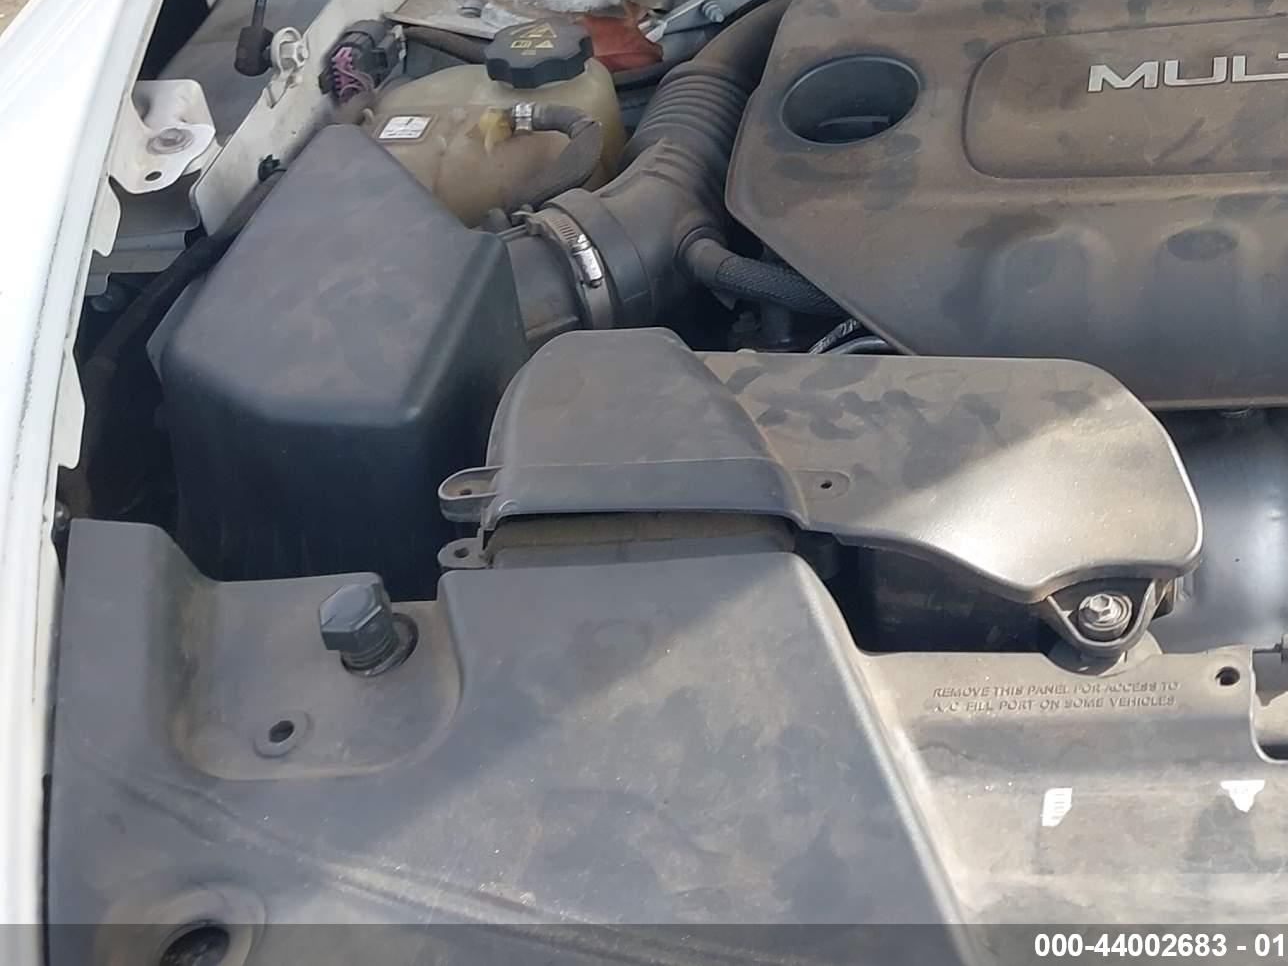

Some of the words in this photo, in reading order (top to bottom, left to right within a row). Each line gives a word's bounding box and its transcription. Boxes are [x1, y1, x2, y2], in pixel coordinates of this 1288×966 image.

[933, 686, 990, 698] REMOVE
[994, 685, 1023, 697] THIS
[1027, 684, 1070, 696] PANEL
[1073, 683, 1100, 694] FOR
[1105, 682, 1157, 693] ACCESS
[1162, 681, 1179, 692] TO
[966, 700, 993, 712] FILL
[999, 699, 1034, 710] PORT
[1039, 699, 1060, 710] ON
[1064, 698, 1104, 709] SOME
[1109, 696, 1176, 708] VEHICLES
